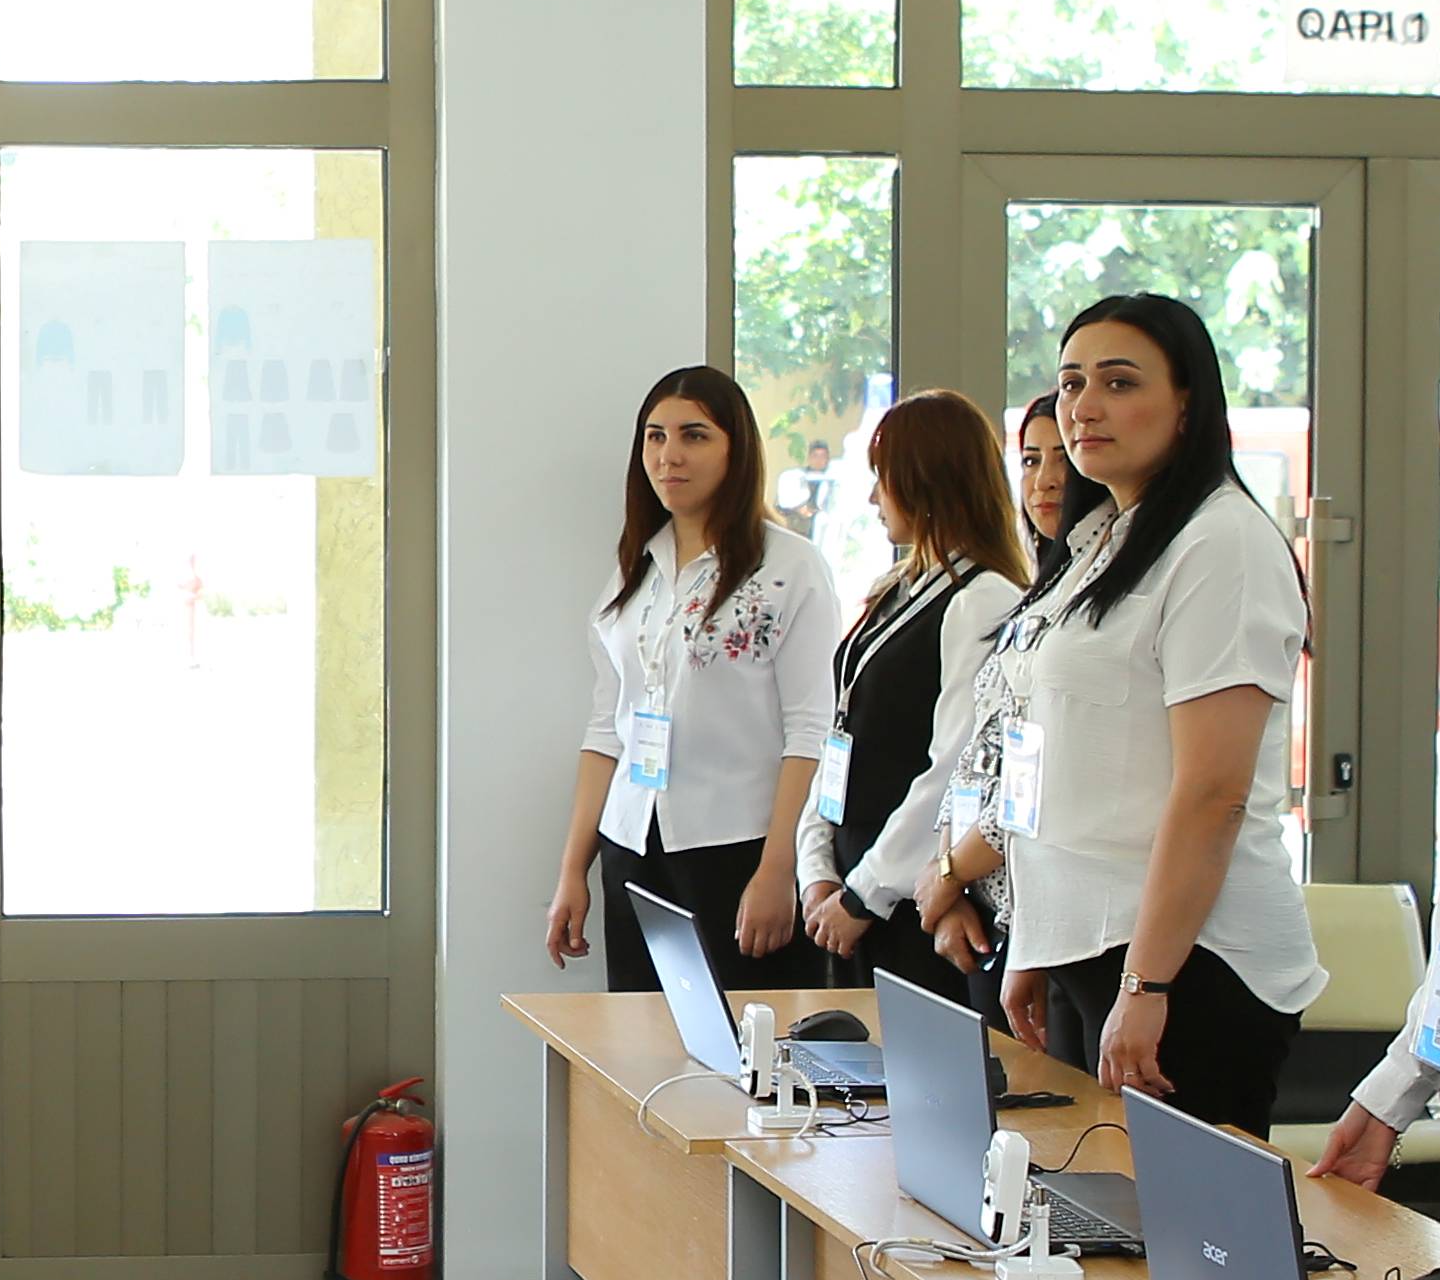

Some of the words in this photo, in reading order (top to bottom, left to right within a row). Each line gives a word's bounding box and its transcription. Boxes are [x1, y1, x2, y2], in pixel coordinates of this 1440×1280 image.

[1297, 7, 1394, 42] QAPI
[1409, 12, 1425, 43] 1
[1203, 1240, 1228, 1266] acer
